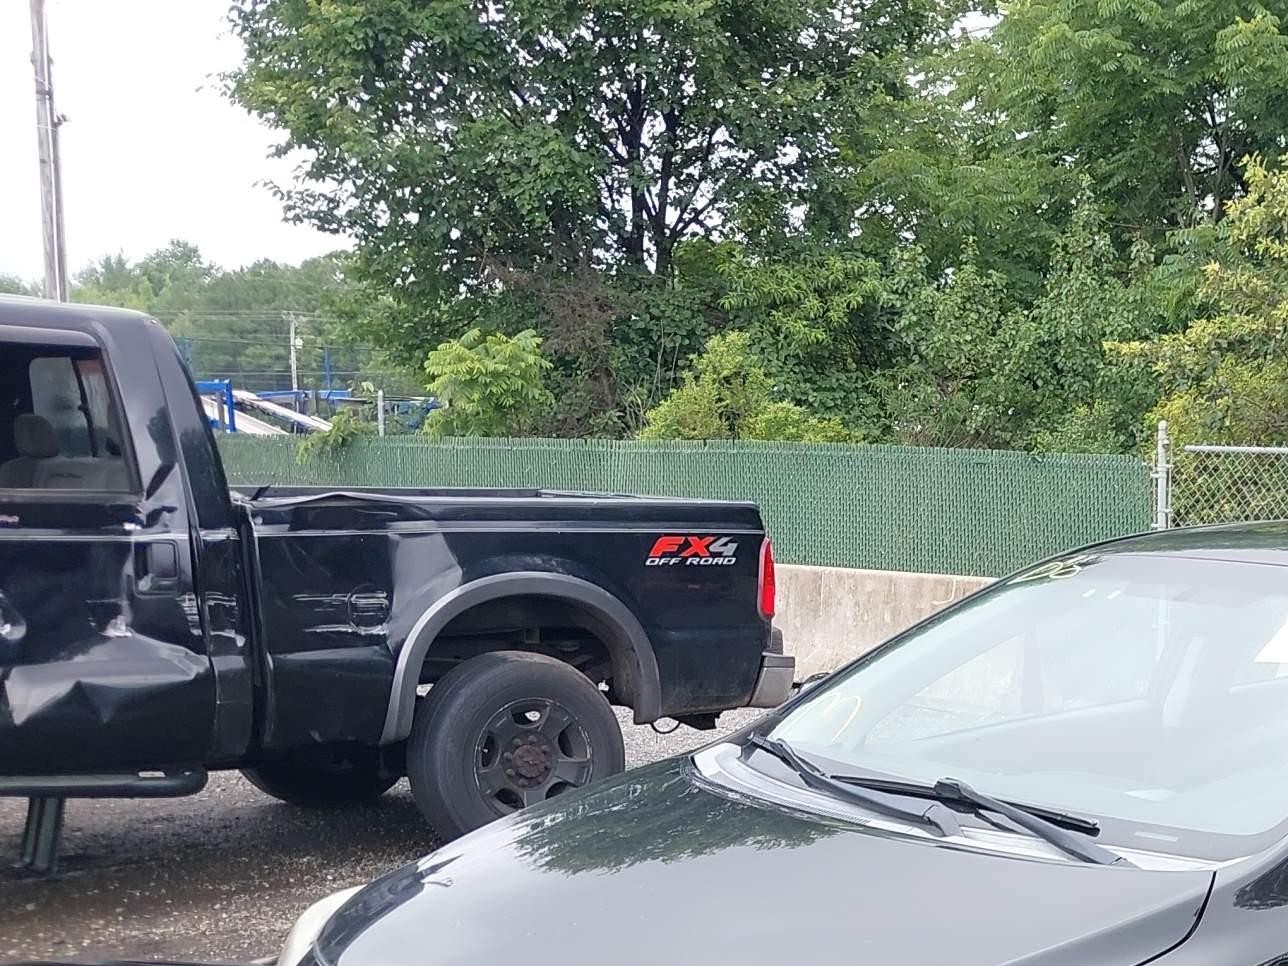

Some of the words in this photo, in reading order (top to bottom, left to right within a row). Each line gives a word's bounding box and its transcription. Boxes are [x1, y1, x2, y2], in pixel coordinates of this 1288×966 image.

[649, 536, 739, 557] FX4
[645, 557, 682, 566] OFF
[685, 557, 737, 566] ROAD
